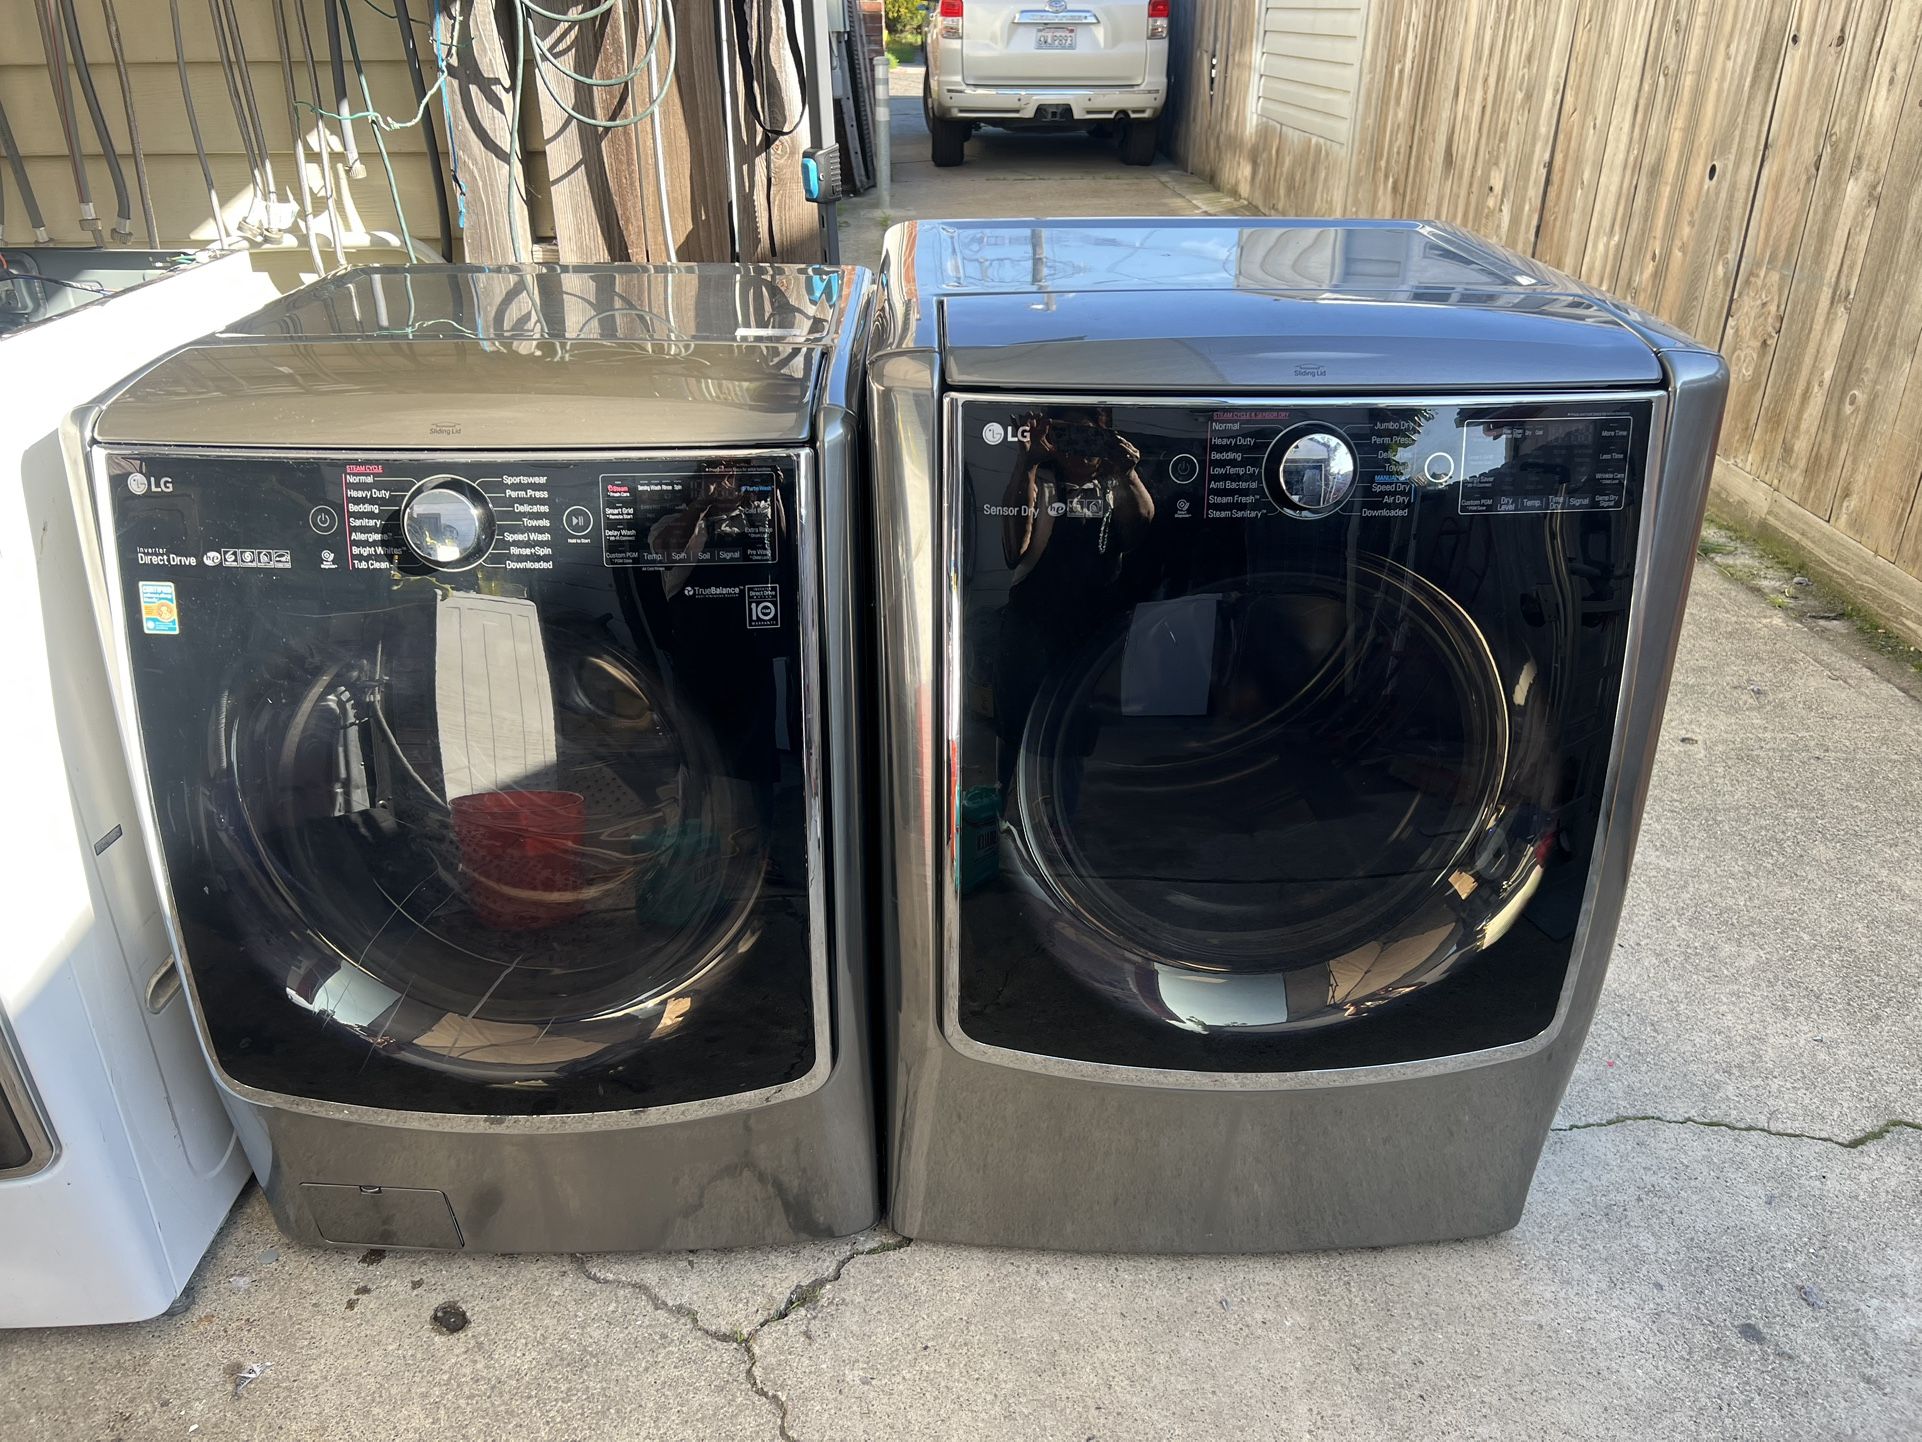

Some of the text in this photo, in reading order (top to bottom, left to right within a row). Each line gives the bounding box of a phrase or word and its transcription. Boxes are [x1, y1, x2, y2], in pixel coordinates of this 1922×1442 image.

[1212, 422, 1240, 430] Normal
[1374, 422, 1414, 431] Jumbo Dry
[1008, 426, 1030, 442] LG
[1212, 437, 1255, 446] Heavy Duty
[1211, 452, 1242, 461] Bedding
[1246, 466, 1259, 476] Dry
[346, 475, 374, 483] Normal
[503, 475, 547, 484] Sportswear
[150, 477, 172, 492] LG
[1226, 480, 1258, 488] Bacterial
[1372, 484, 1410, 493] Speed Dry
[348, 490, 390, 500] Heavy Duty
[1209, 495, 1231, 503] Steam
[1396, 496, 1409, 504] Dry
[349, 504, 379, 514] Bedding
[514, 504, 549, 512] Delicates
[984, 504, 1040, 518] Sensor Dry
[1362, 508, 1408, 516] Downloaded
[1208, 510, 1230, 518] Steam
[350, 518, 380, 528] Sanitary
[522, 518, 550, 526] Towels
[504, 532, 551, 542] Speed Wash
[352, 546, 375, 556] Bright
[510, 546, 552, 556] Rinse+Spin
[720, 550, 740, 558] Signal
[138, 554, 196, 566] Direct Drive
[368, 560, 389, 568] Clean
[506, 560, 552, 569] Downloaded
[751, 602, 776, 620] 10
